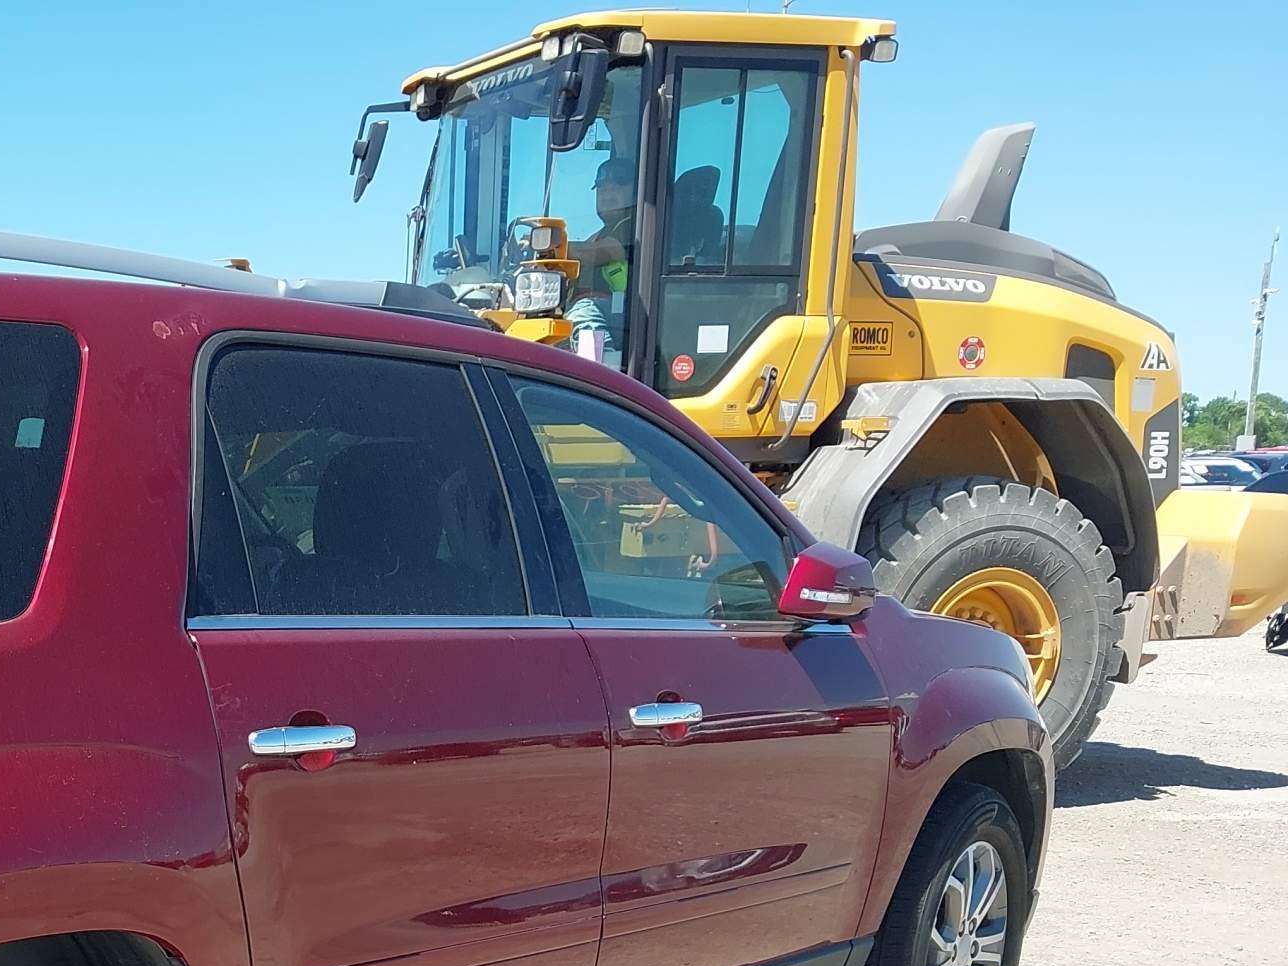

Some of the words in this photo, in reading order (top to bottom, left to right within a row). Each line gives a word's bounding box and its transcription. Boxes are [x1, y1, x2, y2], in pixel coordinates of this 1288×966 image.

[467, 63, 534, 99] VOLVO
[886, 273, 986, 293] VOLVO
[852, 327, 889, 345] ROMCO
[1148, 431, 1170, 479] L90H
[958, 535, 1074, 590] TITAN
